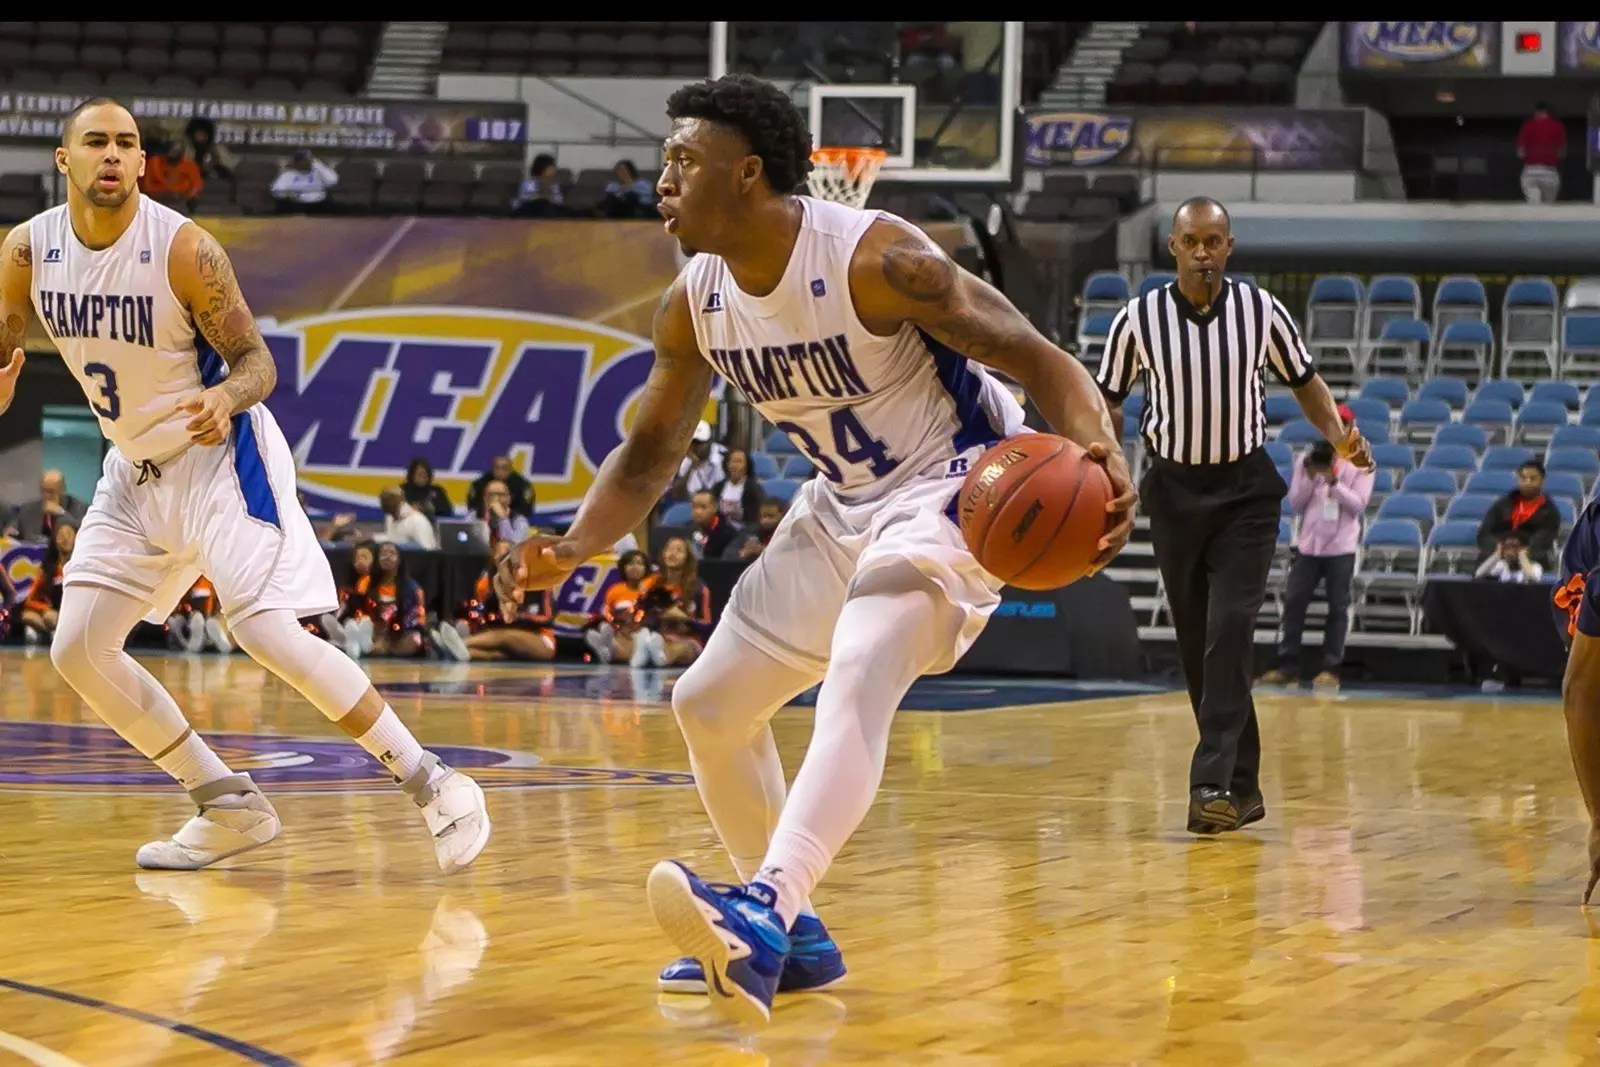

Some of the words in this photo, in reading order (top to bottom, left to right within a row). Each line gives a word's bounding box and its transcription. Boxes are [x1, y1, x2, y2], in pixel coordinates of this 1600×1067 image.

[133, 100, 194, 118] NORTH
[333, 106, 385, 124] STATE
[479, 120, 522, 140] 107
[40, 290, 155, 348] HAMPTON
[84, 362, 121, 421] 3
[708, 334, 872, 404] HAMPTON
[775, 405, 900, 484] 34
